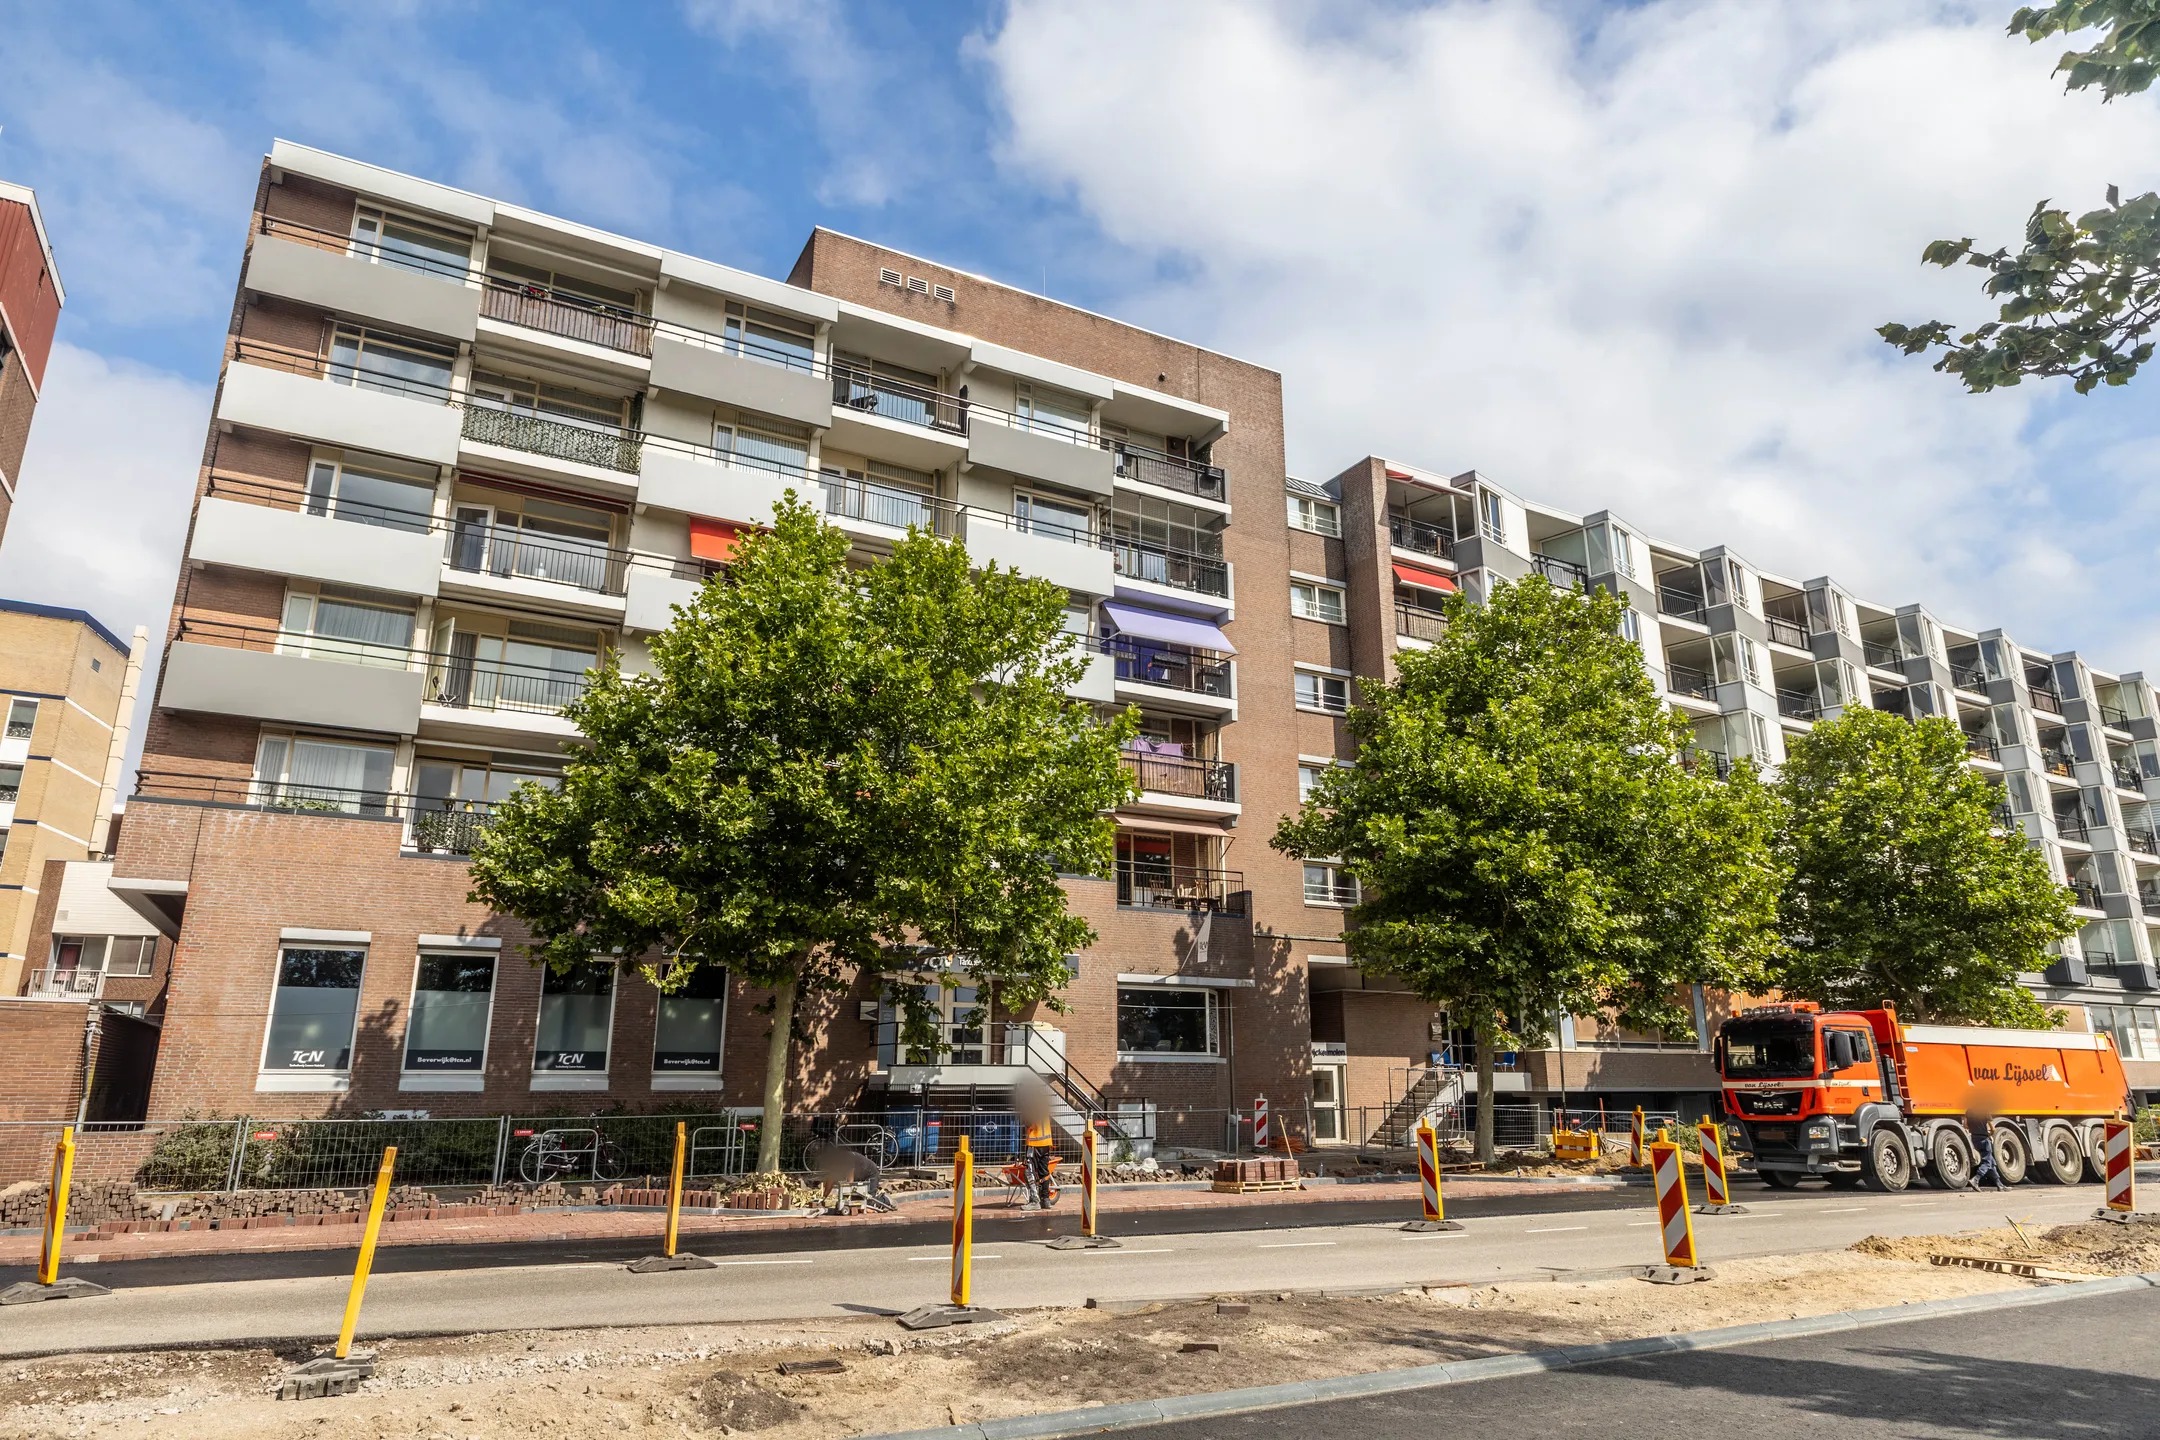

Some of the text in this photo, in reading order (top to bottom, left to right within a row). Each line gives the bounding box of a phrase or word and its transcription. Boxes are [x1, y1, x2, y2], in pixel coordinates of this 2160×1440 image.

[291, 1050, 325, 1063] TCN
[558, 1053, 584, 1065] TCN
[1974, 1067, 2000, 1081] van
[1753, 1101, 1784, 1109] MAN
